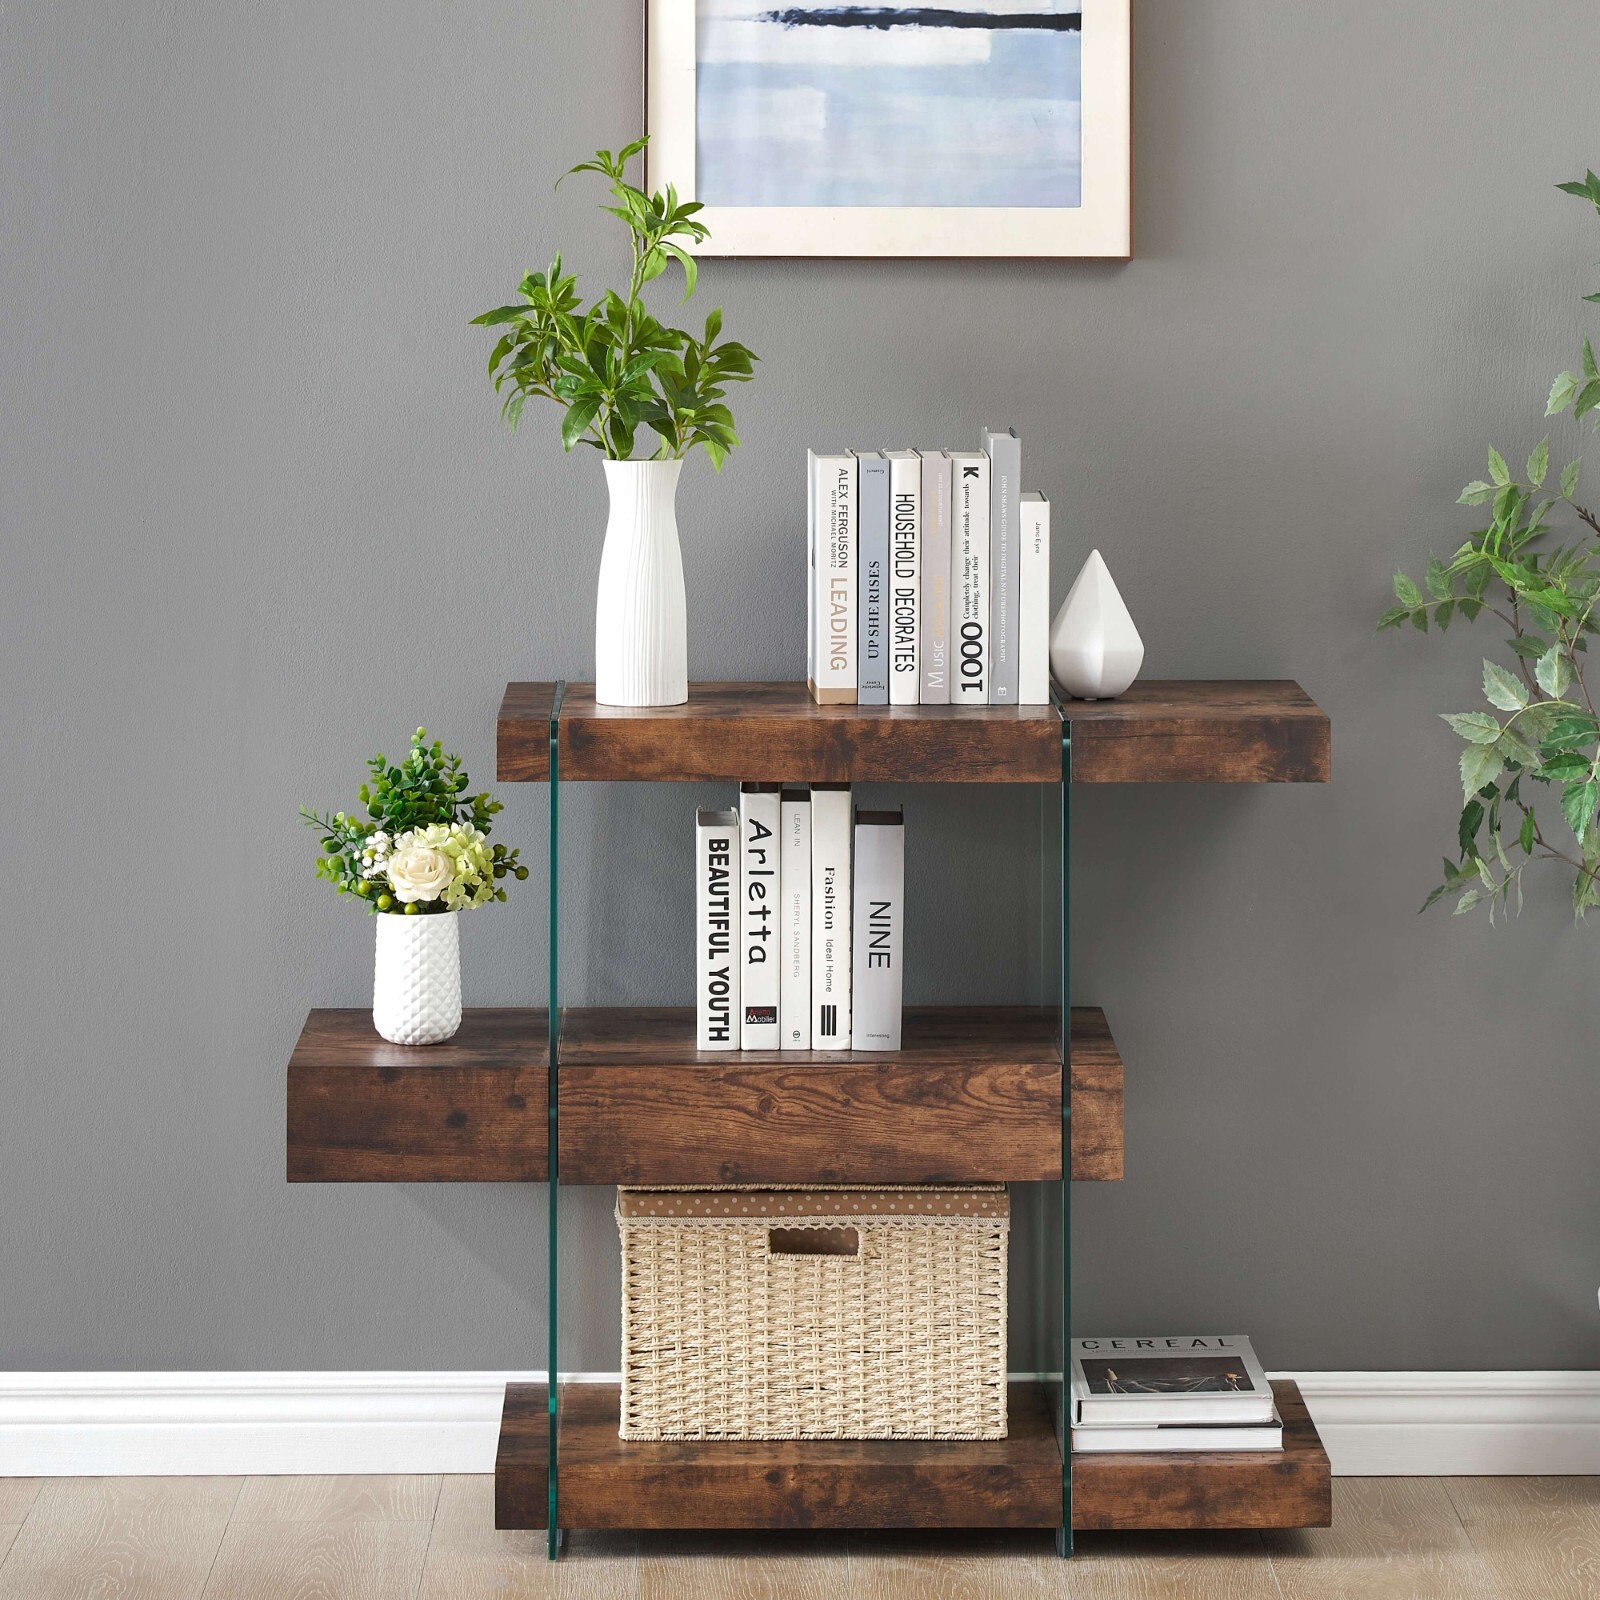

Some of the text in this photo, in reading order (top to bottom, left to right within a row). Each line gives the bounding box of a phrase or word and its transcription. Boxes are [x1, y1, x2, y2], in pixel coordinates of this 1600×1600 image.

[838, 468, 849, 568] ALEX FERGUSON
[1001, 542, 1007, 552] TO
[895, 494, 915, 672] HOUSEHOLD DECORATES
[962, 582, 972, 619] Completely
[963, 556, 971, 580] change
[830, 577, 848, 671] LEADING
[868, 561, 880, 659] UP SHE RISES
[972, 590, 980, 619] clothing,
[960, 622, 983, 692] 1000
[794, 838, 801, 847] IN
[748, 818, 775, 965] Arletta
[708, 838, 729, 1042] BEAUTIFUL YOUTH
[824, 867, 835, 993] Fashion Ideal Home
[868, 902, 891, 969] NINE
[1082, 1338, 1234, 1350] CEREAL
